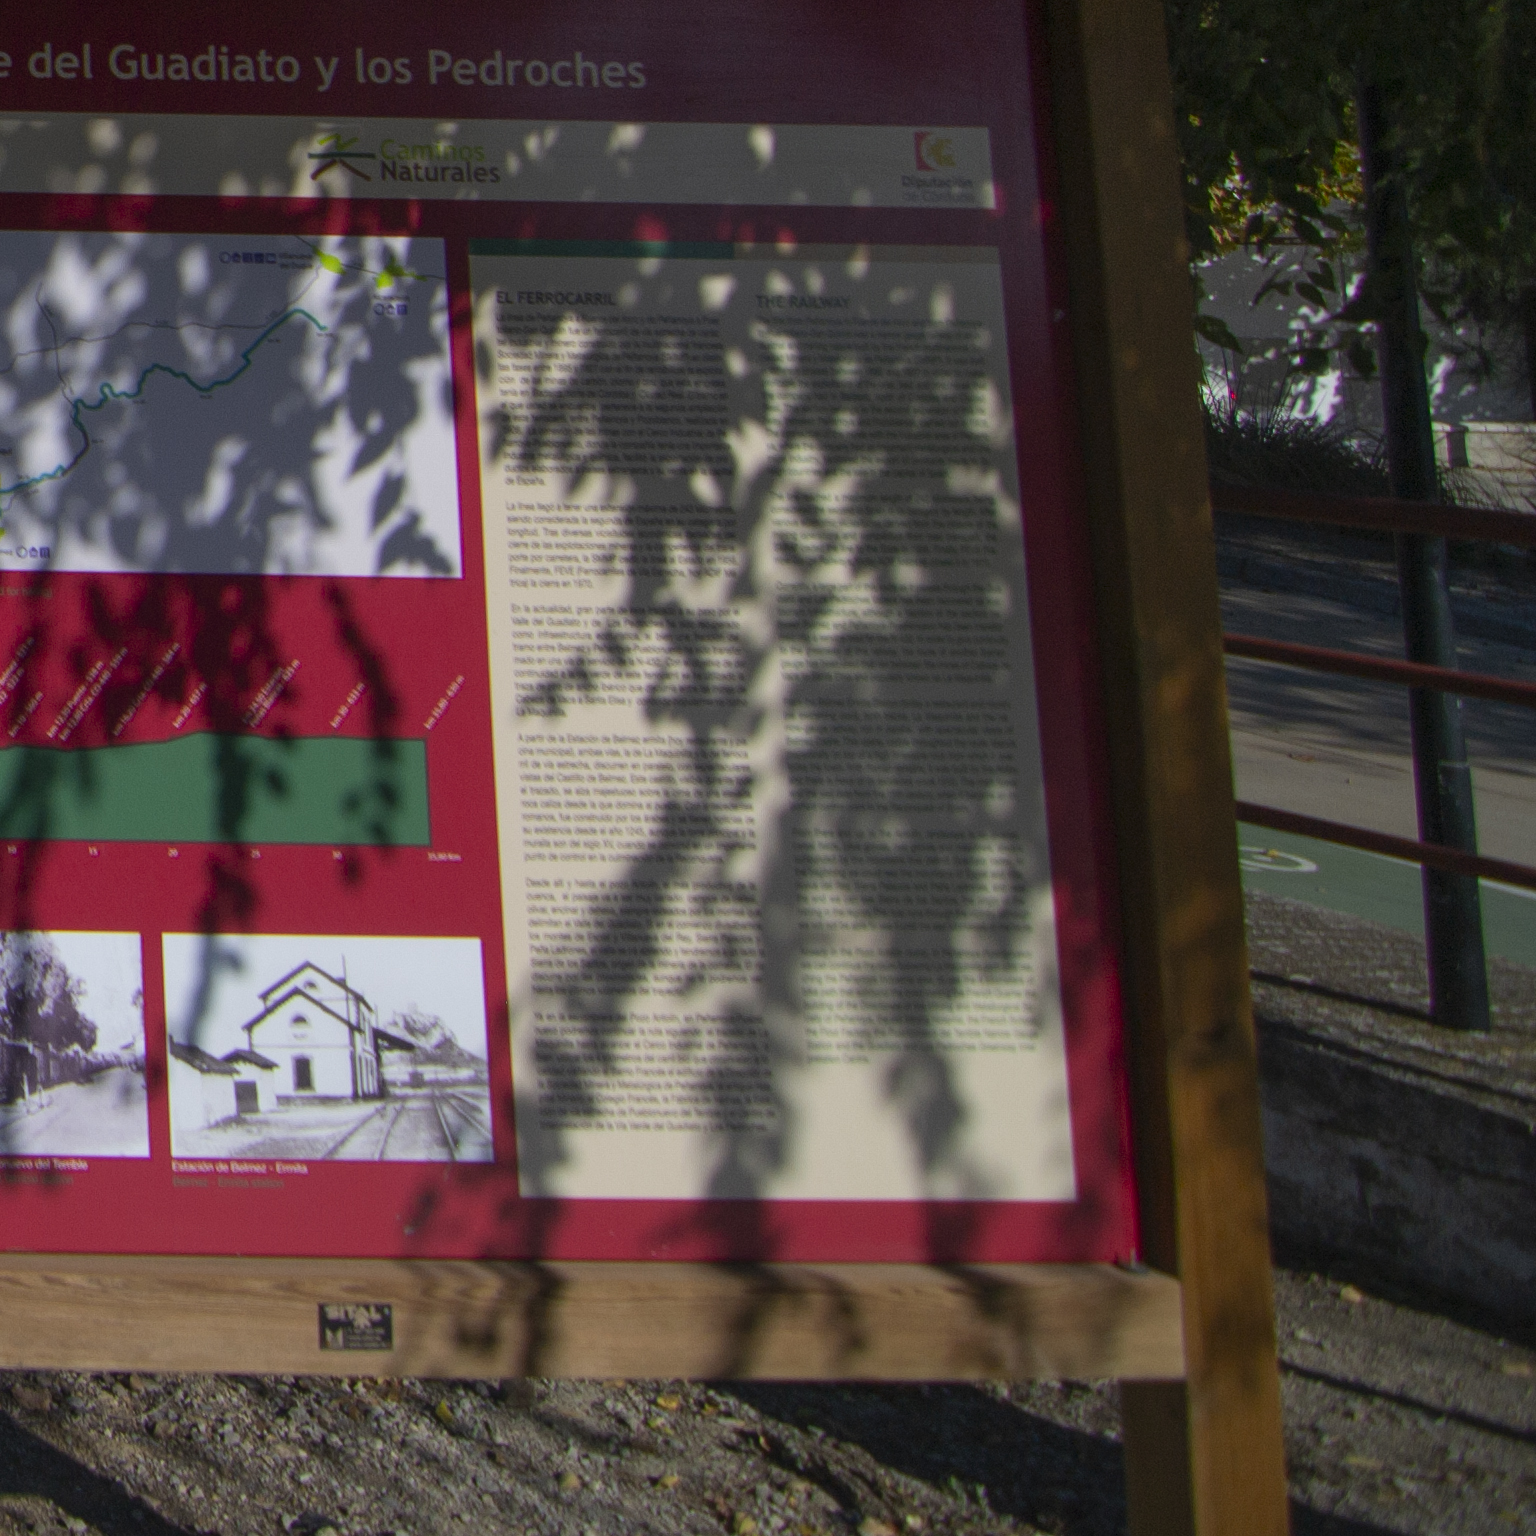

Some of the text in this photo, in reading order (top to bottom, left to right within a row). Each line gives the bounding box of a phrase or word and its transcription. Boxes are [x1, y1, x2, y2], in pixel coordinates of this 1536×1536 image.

[28, 42, 93, 80] del
[109, 44, 300, 84] Guadiato
[317, 58, 339, 91] y
[356, 48, 412, 86] los
[430, 49, 647, 90] Pedroches
[380, 139, 486, 162] Caminos
[380, 161, 501, 183] Naturales
[496, 290, 616, 307] EL FERROCARRIL
[756, 295, 850, 310] THE RAILWAY
